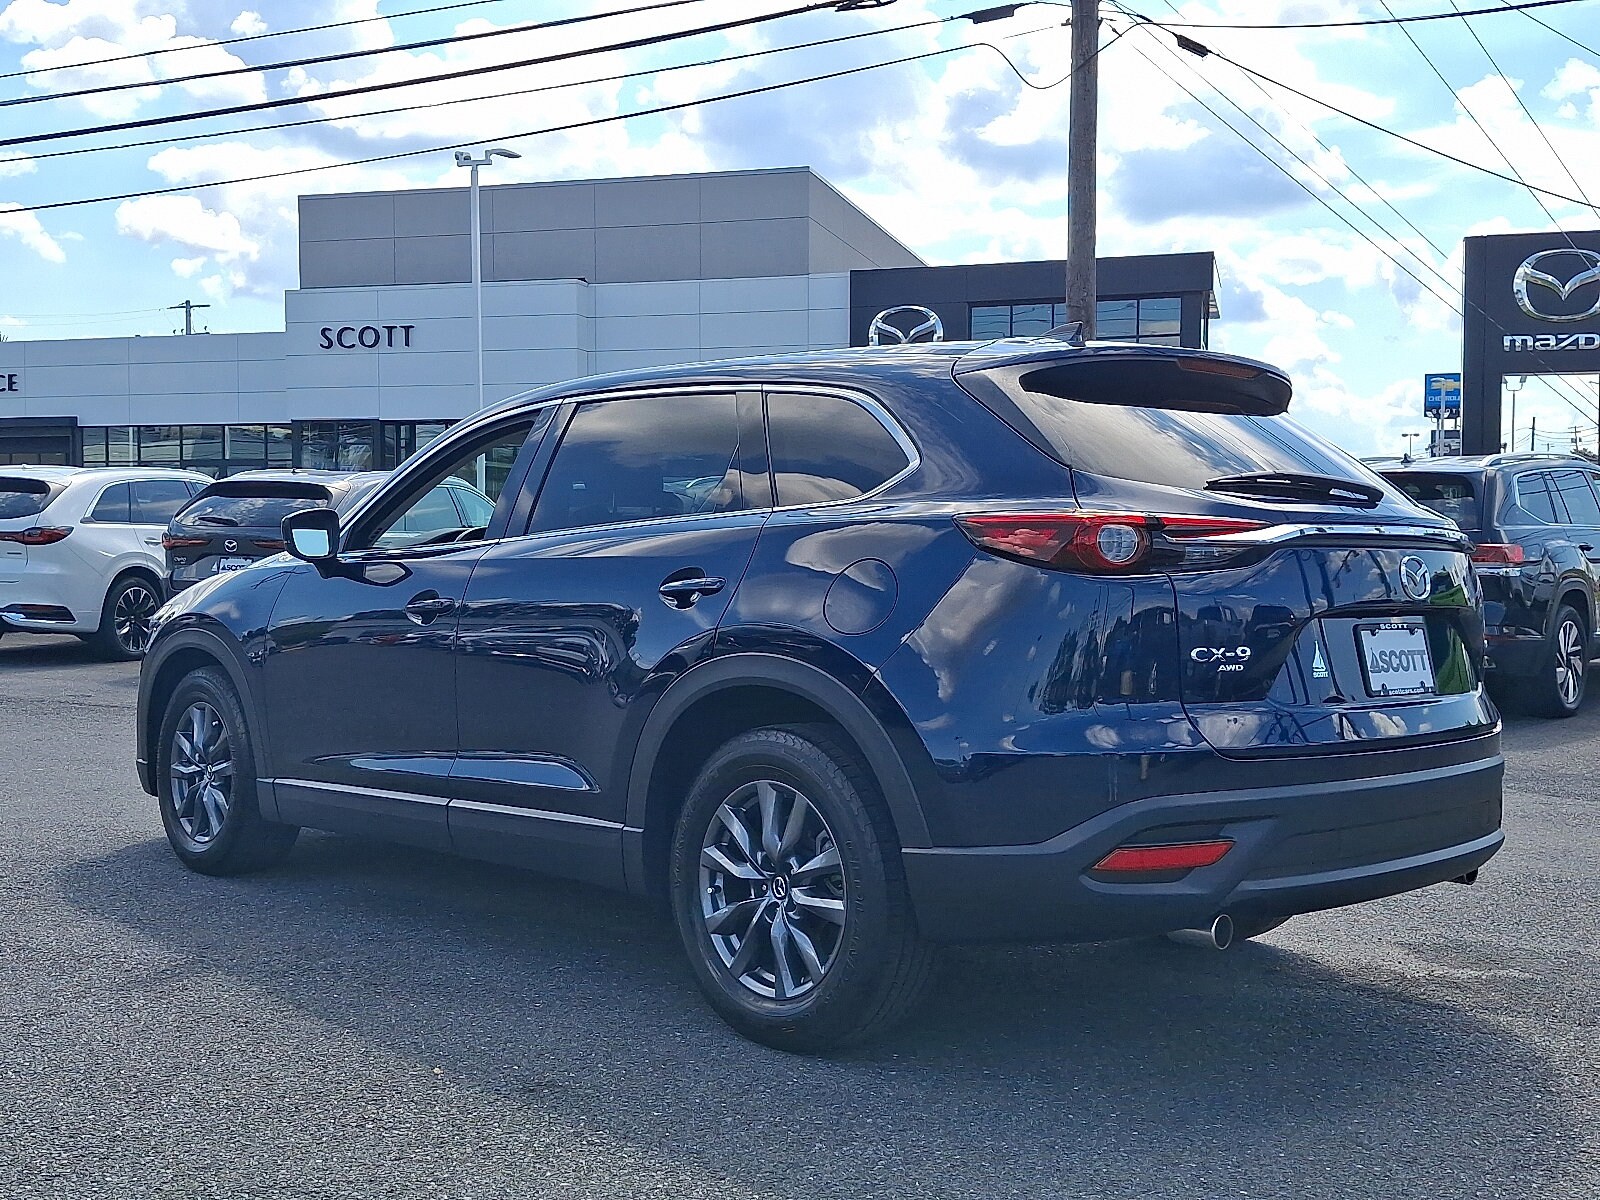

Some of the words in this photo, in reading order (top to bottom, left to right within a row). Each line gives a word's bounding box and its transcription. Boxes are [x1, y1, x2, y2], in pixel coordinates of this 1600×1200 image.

[319, 324, 415, 350] SCOTT
[1190, 646, 1252, 662] CX-9
[1379, 649, 1427, 673] SCOTT
[1217, 664, 1244, 672] AWD
[1388, 687, 1425, 695] scottcars.com
